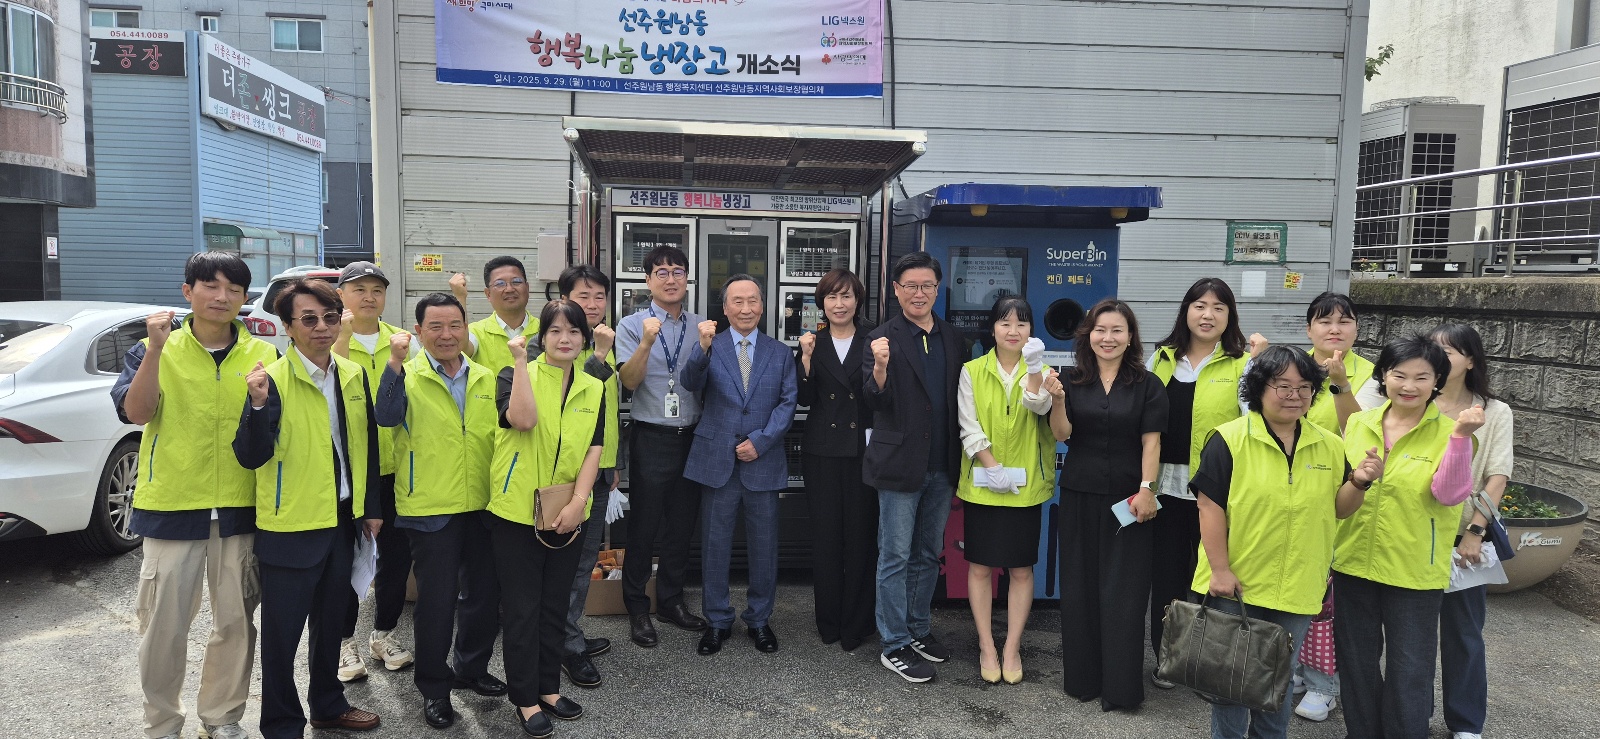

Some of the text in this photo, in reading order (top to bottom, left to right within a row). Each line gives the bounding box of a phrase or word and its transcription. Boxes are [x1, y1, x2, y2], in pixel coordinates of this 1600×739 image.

[619, 8, 708, 36] 선주원남동
[821, 15, 865, 26] LIG넥스원
[110, 30, 169, 39] 054.441.0089
[115, 44, 163, 70] 공장
[736, 53, 801, 76] 개소식
[493, 73, 511, 83] 일시
[569, 77, 584, 88] (월)
[586, 78, 611, 88] 11:00
[623, 81, 663, 92] 선주원남동
[665, 82, 713, 92] 행정복지센터
[715, 83, 824, 94] 선주원남동지역사회보장협의체
[630, 190, 678, 206] 선주원남동
[1234, 231, 1250, 239] CCTV
[1047, 274, 1055, 284] 캔
